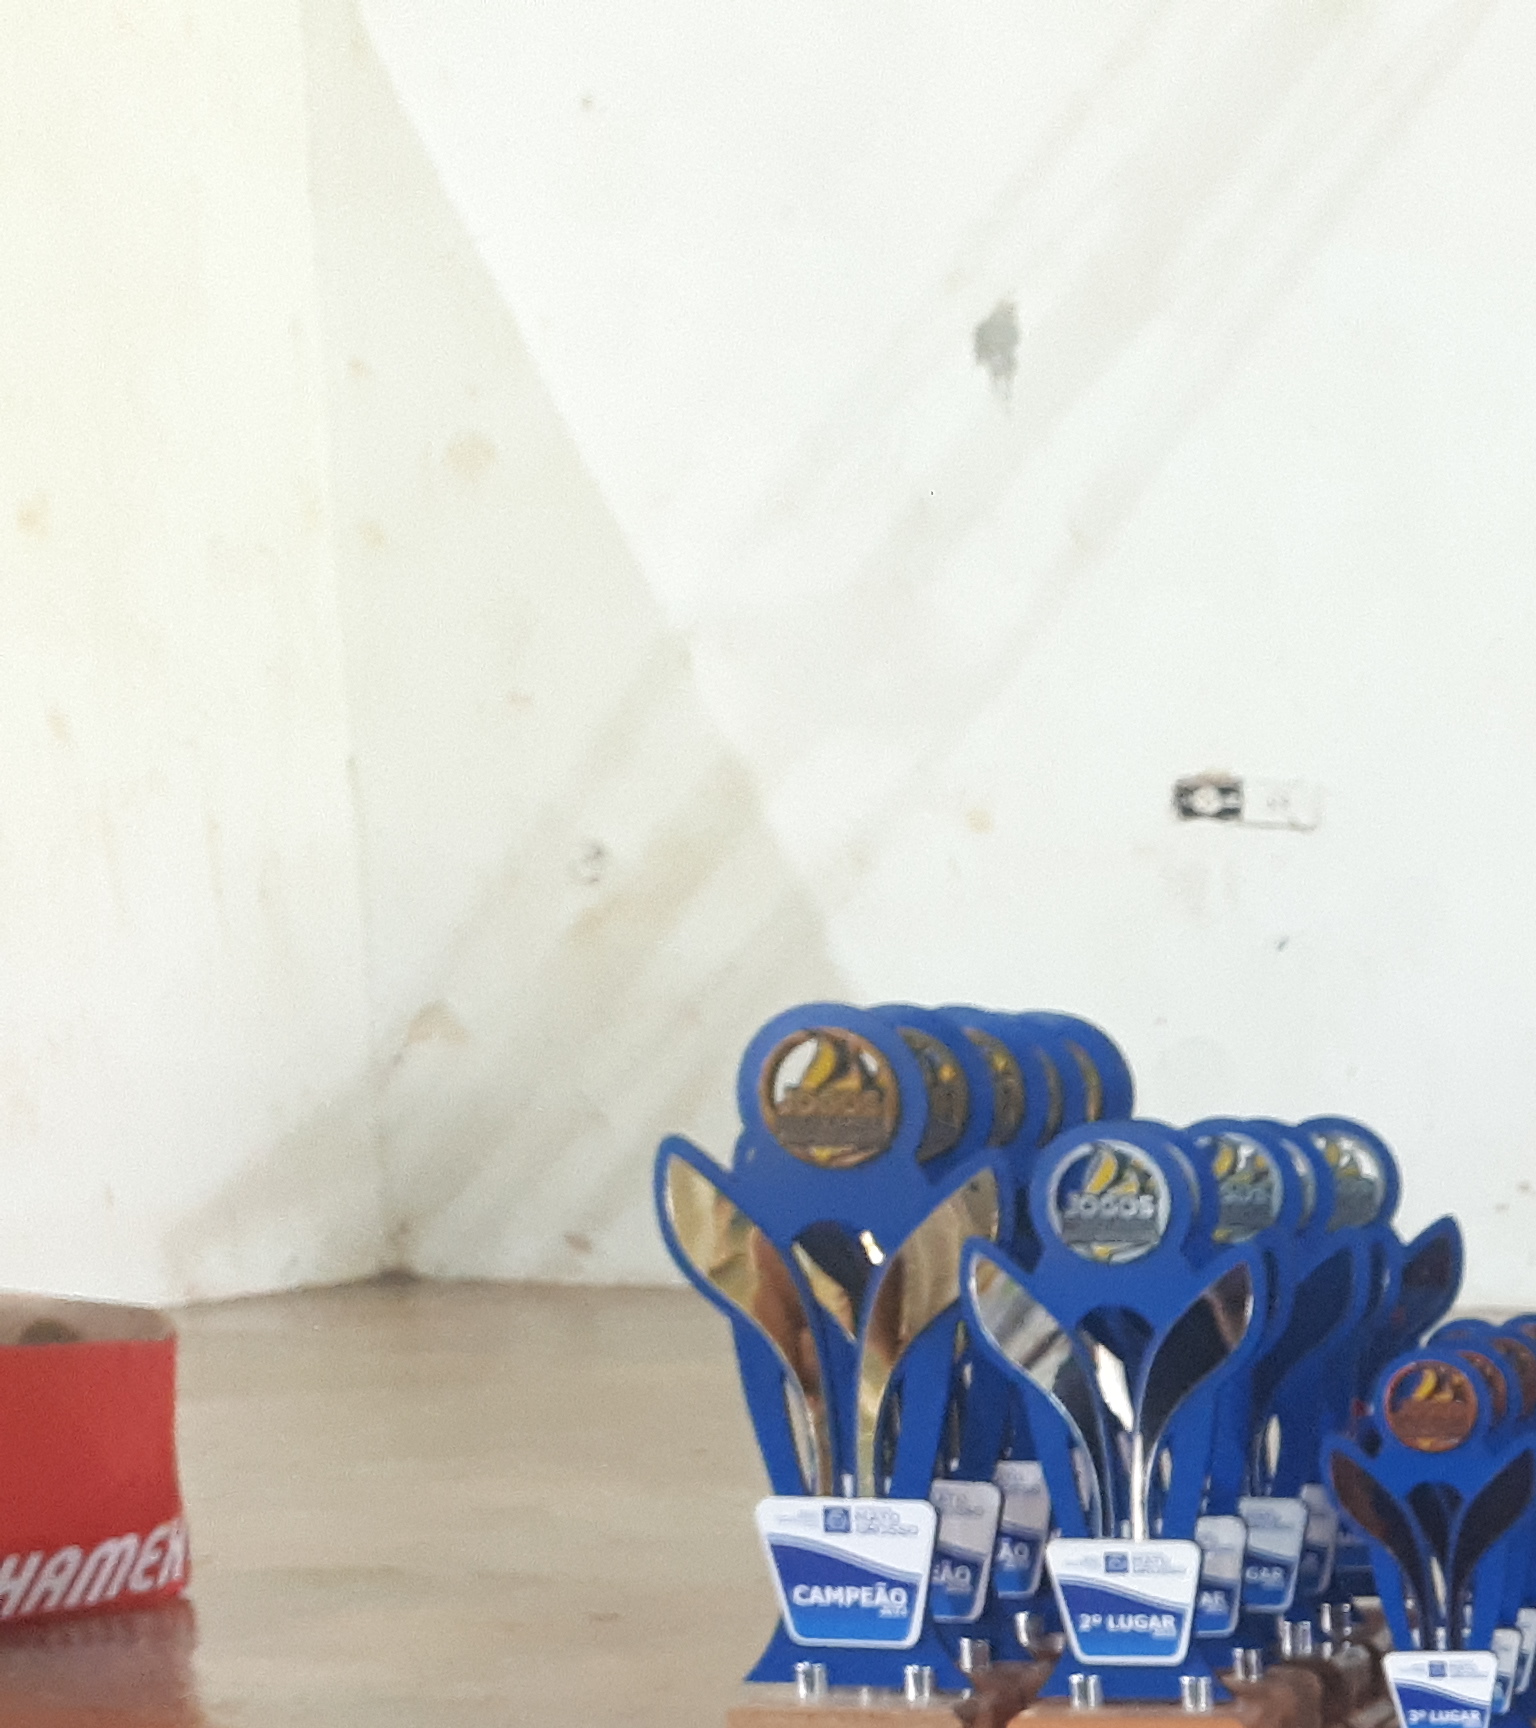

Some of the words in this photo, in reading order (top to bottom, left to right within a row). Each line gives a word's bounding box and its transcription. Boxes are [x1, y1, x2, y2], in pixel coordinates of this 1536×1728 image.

[792, 1581, 909, 1608] CAMPEÃO
[1106, 1614, 1176, 1633] LUGAR
[1429, 1709, 1481, 1724] LUGAR
